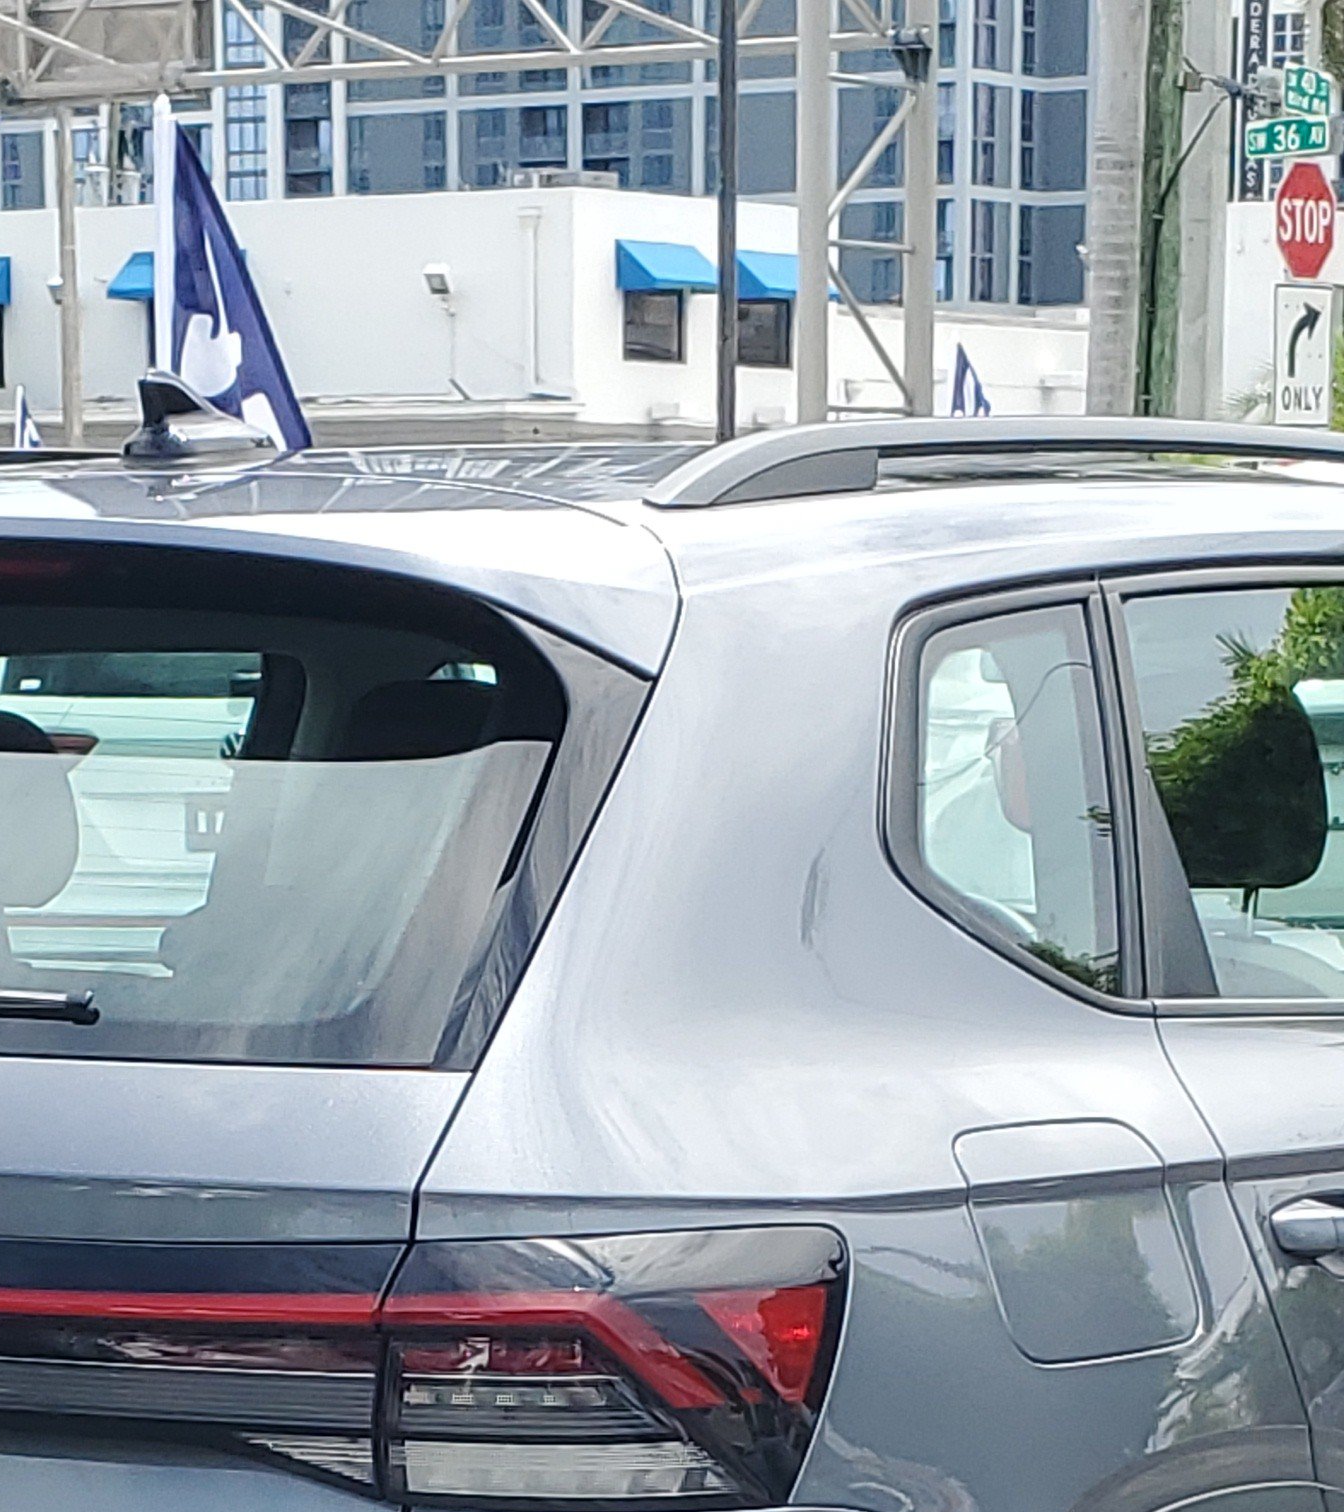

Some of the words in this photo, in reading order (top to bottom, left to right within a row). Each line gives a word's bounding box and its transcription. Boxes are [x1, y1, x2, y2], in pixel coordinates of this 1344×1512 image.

[1248, 132, 1267, 151] SW
[1273, 124, 1301, 151] 36
[1309, 126, 1324, 145] AV
[1279, 197, 1331, 244] STOP
[1281, 385, 1324, 412] ONLY
